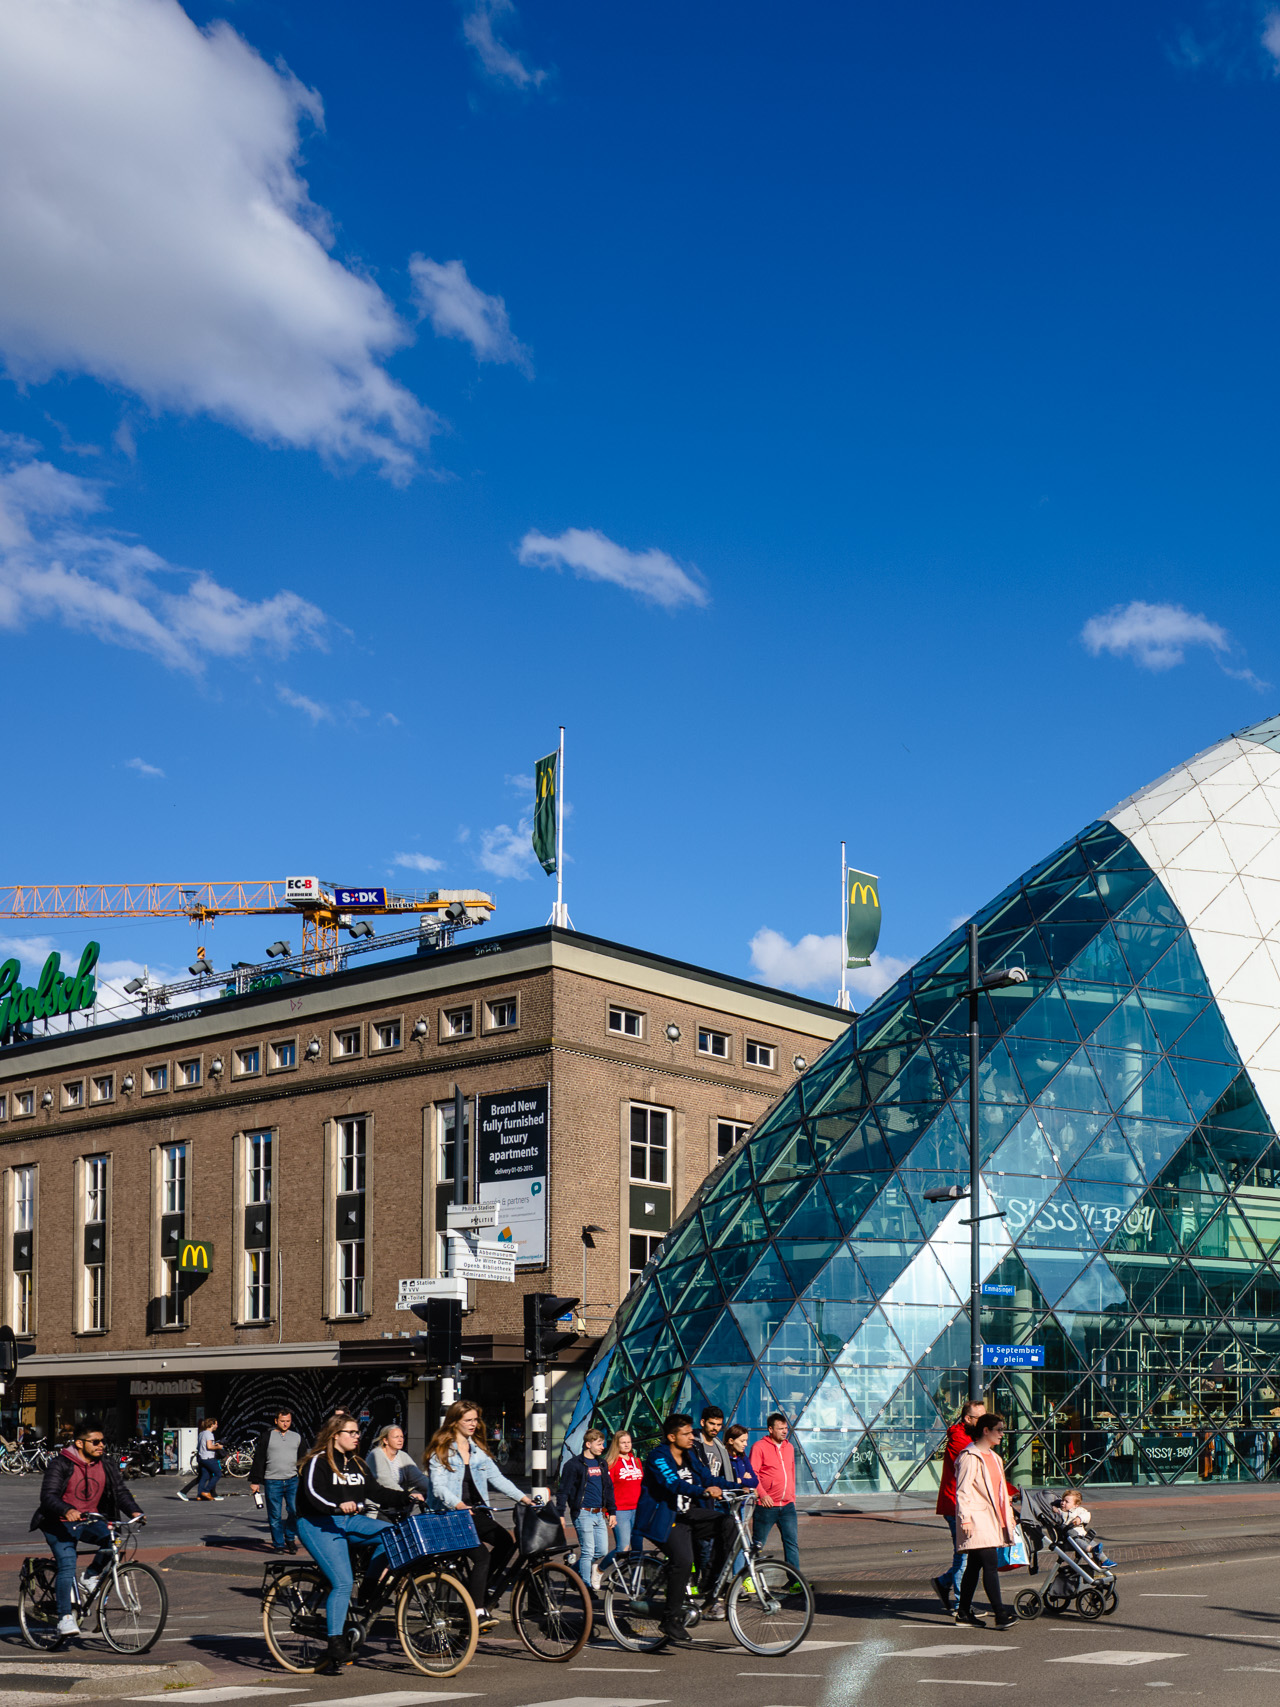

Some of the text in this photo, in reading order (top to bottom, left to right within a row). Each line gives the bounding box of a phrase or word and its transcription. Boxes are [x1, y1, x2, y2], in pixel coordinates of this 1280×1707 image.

[288, 879, 312, 889] EC-B
[491, 1100, 537, 1116] Brand New
[483, 1112, 544, 1133] fully furnished
[500, 1133, 528, 1145] luxury
[489, 1146, 539, 1163] apartments
[494, 1167, 511, 1175] delivery
[507, 1197, 530, 1206] partners
[479, 1250, 513, 1258] Abbemuseum
[482, 1263, 512, 1272] Bibliotheek
[462, 1271, 511, 1281] Admirant shopping
[984, 1285, 1013, 1294] Emmasingel
[996, 1346, 1042, 1354] September-
[1003, 1356, 1024, 1364] plein
[130, 1379, 202, 1395] McDonald's
[1145, 1445, 1194, 1461] SISSY-BOY
